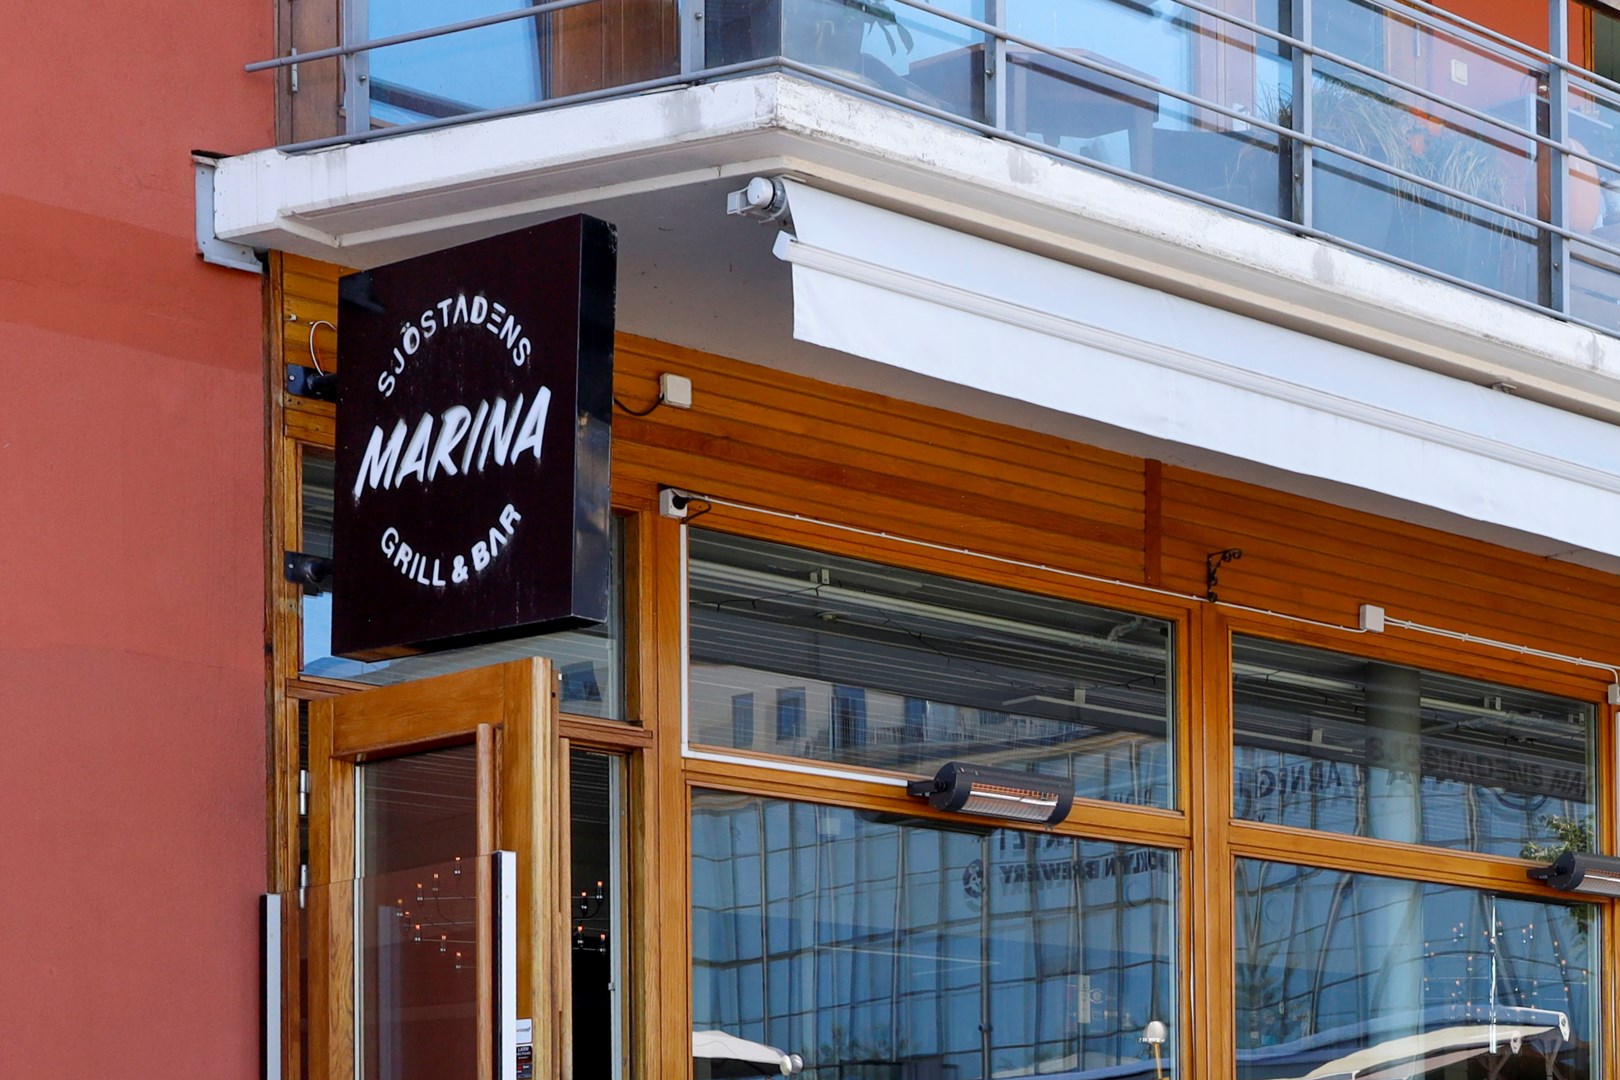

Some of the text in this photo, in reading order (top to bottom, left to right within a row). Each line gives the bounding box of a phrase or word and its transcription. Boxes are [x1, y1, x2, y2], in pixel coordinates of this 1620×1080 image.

[377, 294, 532, 397] SJÖSTADENS
[353, 385, 552, 501] MARINA
[380, 503, 522, 587] GRILL & BAR
